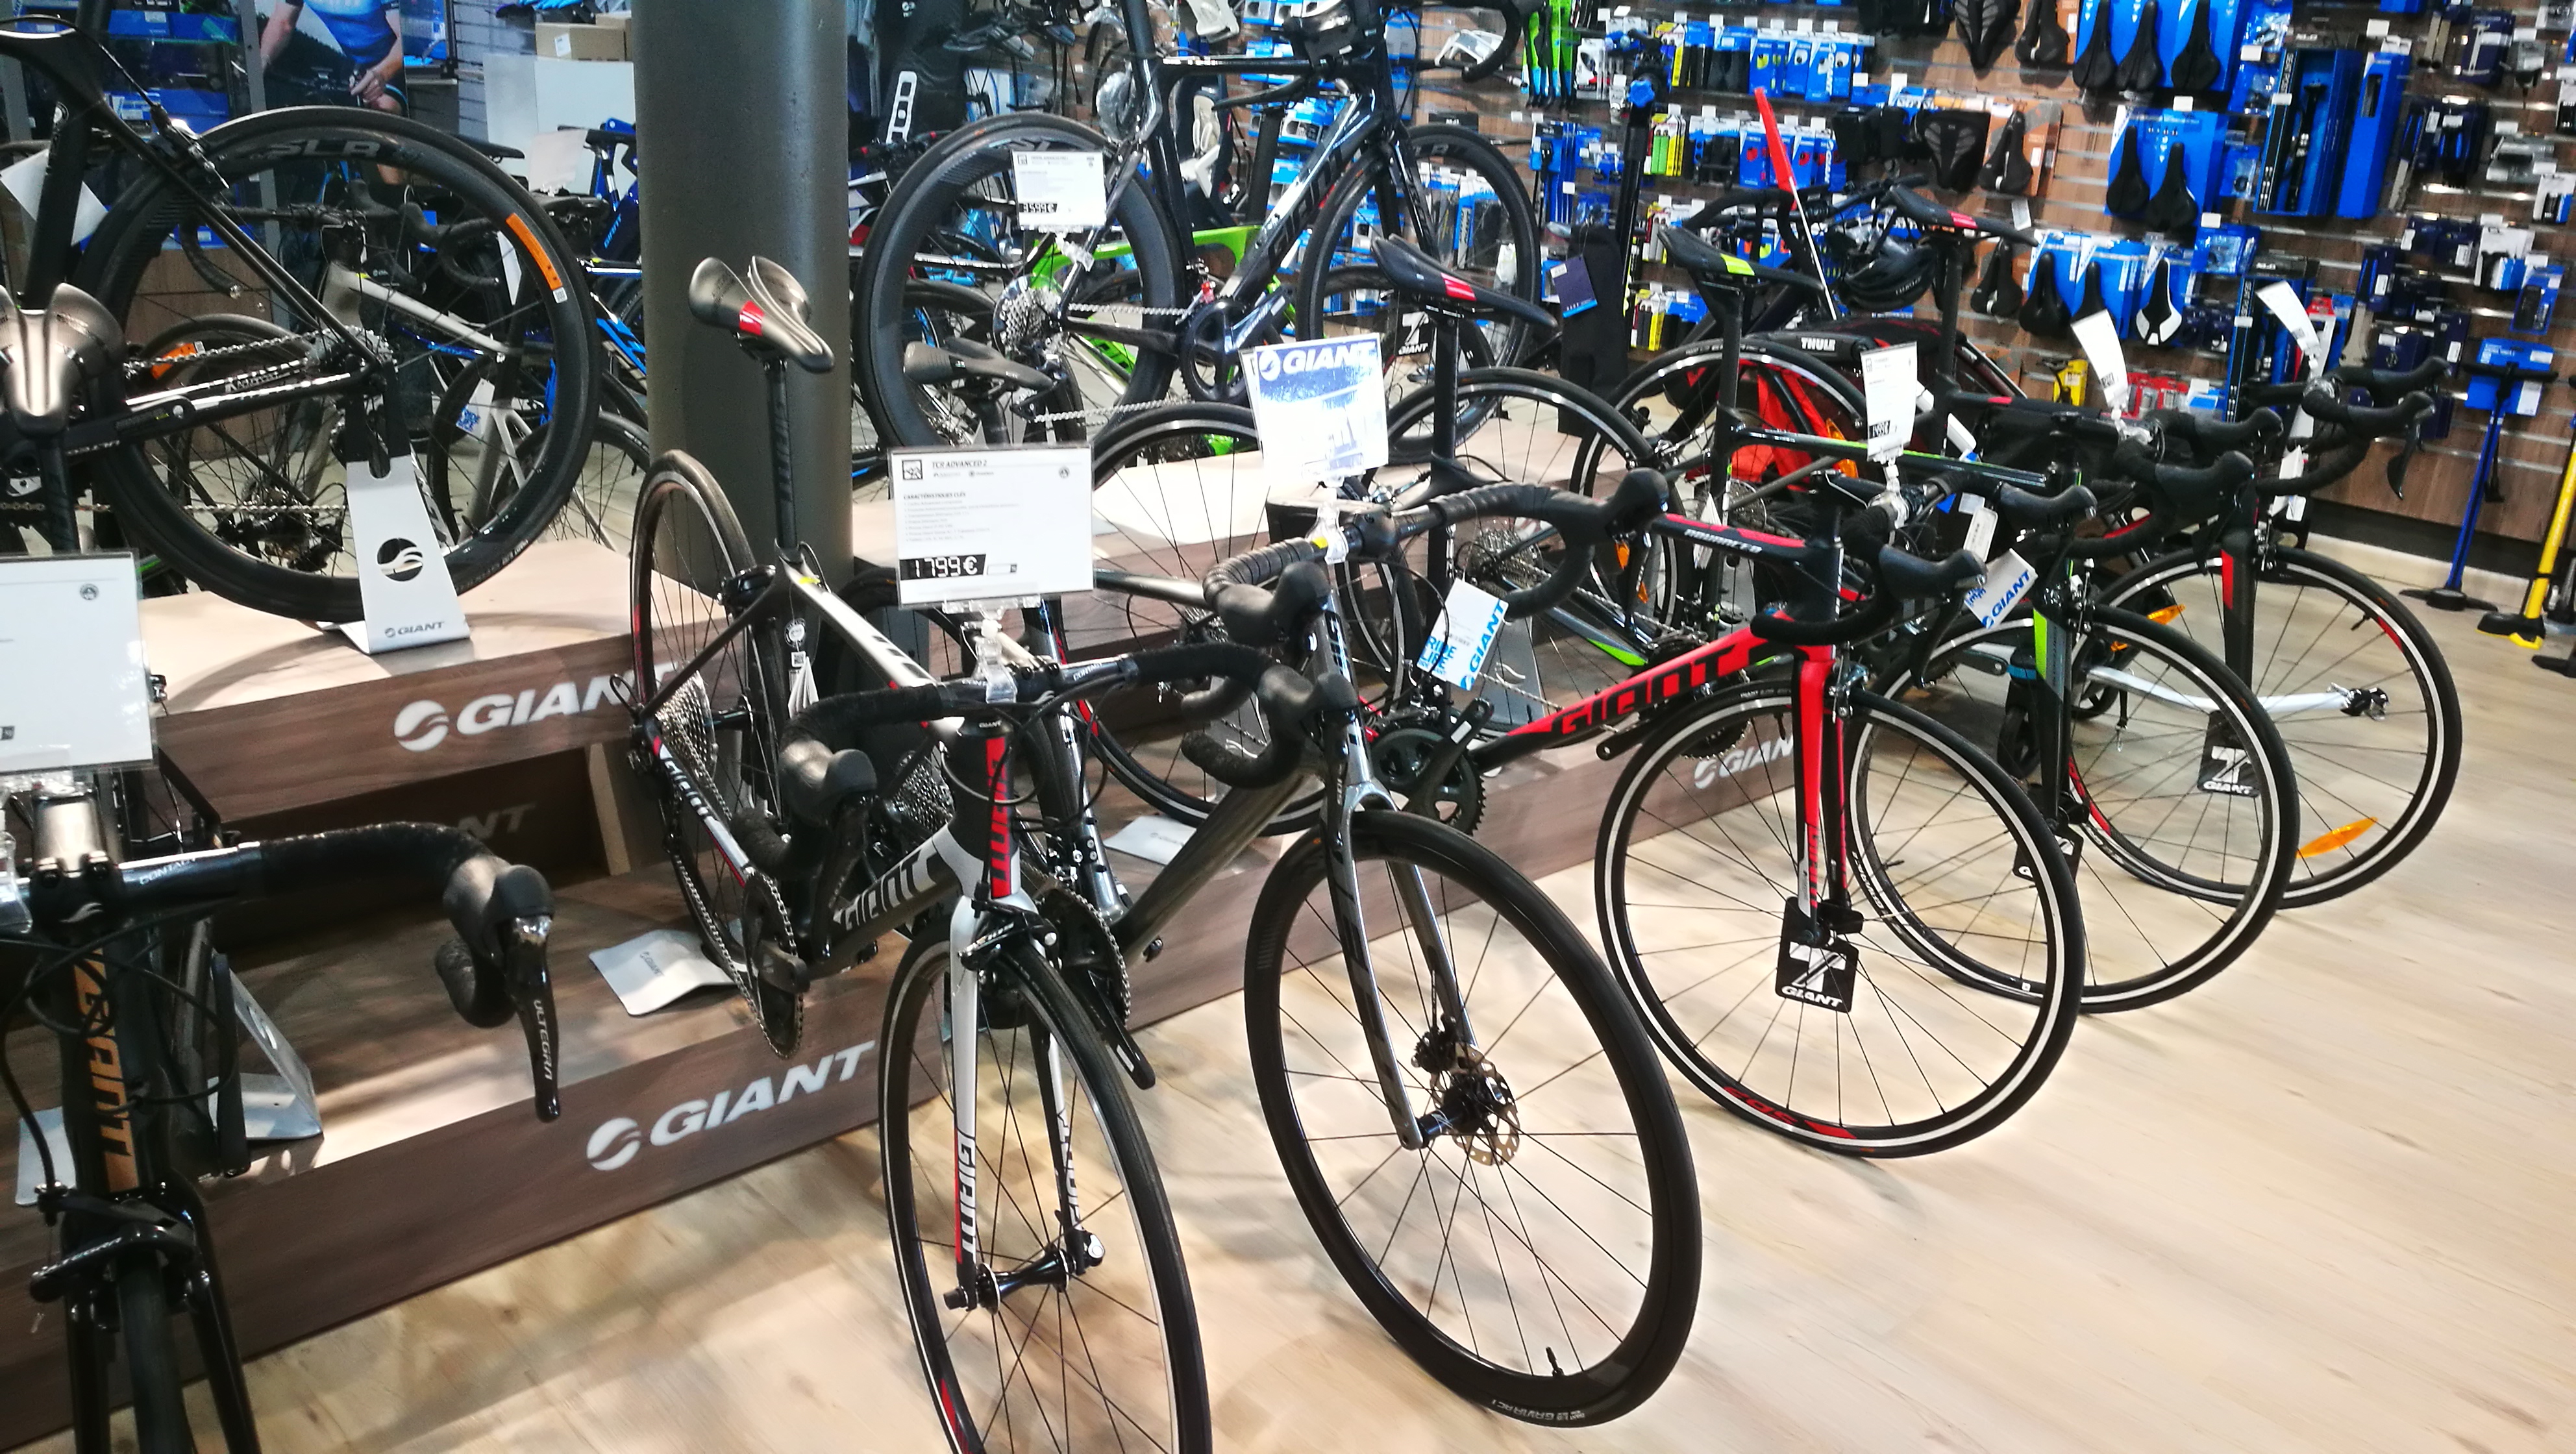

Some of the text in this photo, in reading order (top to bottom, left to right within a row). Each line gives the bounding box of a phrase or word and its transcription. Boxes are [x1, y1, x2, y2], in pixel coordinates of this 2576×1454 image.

[1398, 343, 1428, 355] GIANT
[1800, 337, 1836, 352] THULE
[1992, 570, 2030, 618] GIANT
[397, 621, 444, 635] GIANT
[1469, 598, 1504, 673] GIANT
[1551, 644, 1738, 735] GIANT
[1718, 733, 1794, 778] GIAN
[1781, 985, 1843, 1008] GIANT
[534, 1000, 552, 1080] ULTEGRA
[650, 1041, 875, 1146] GIANT
[958, 1133, 976, 1255] GIANT
